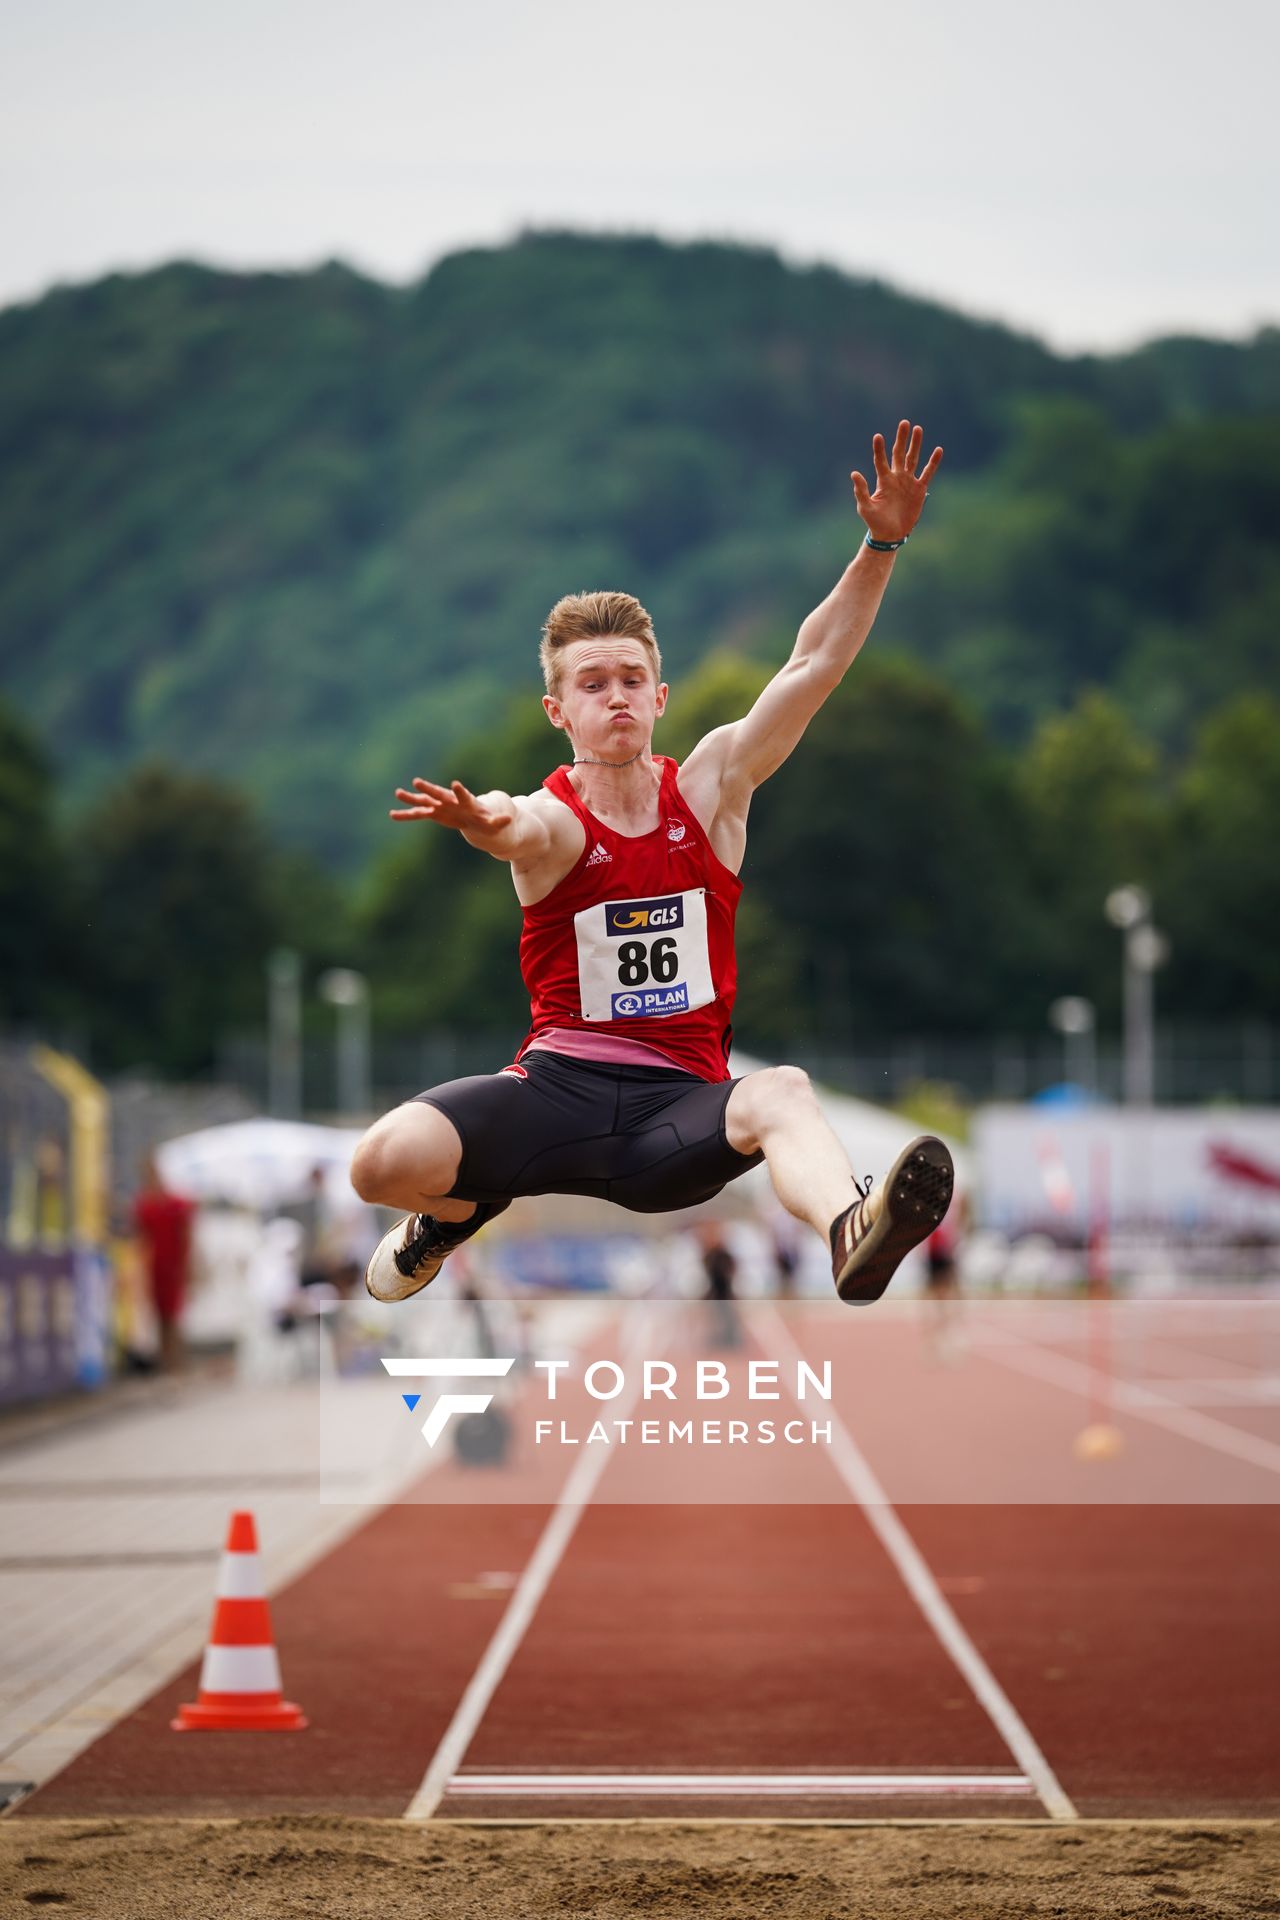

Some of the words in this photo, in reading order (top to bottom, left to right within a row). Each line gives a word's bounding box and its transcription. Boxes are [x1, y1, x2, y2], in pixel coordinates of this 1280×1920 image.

[649, 906, 678, 926] GLS
[617, 937, 679, 987] 86
[644, 989, 686, 1007] PLAN
[645, 1003, 686, 1013] INTERNATIONAL
